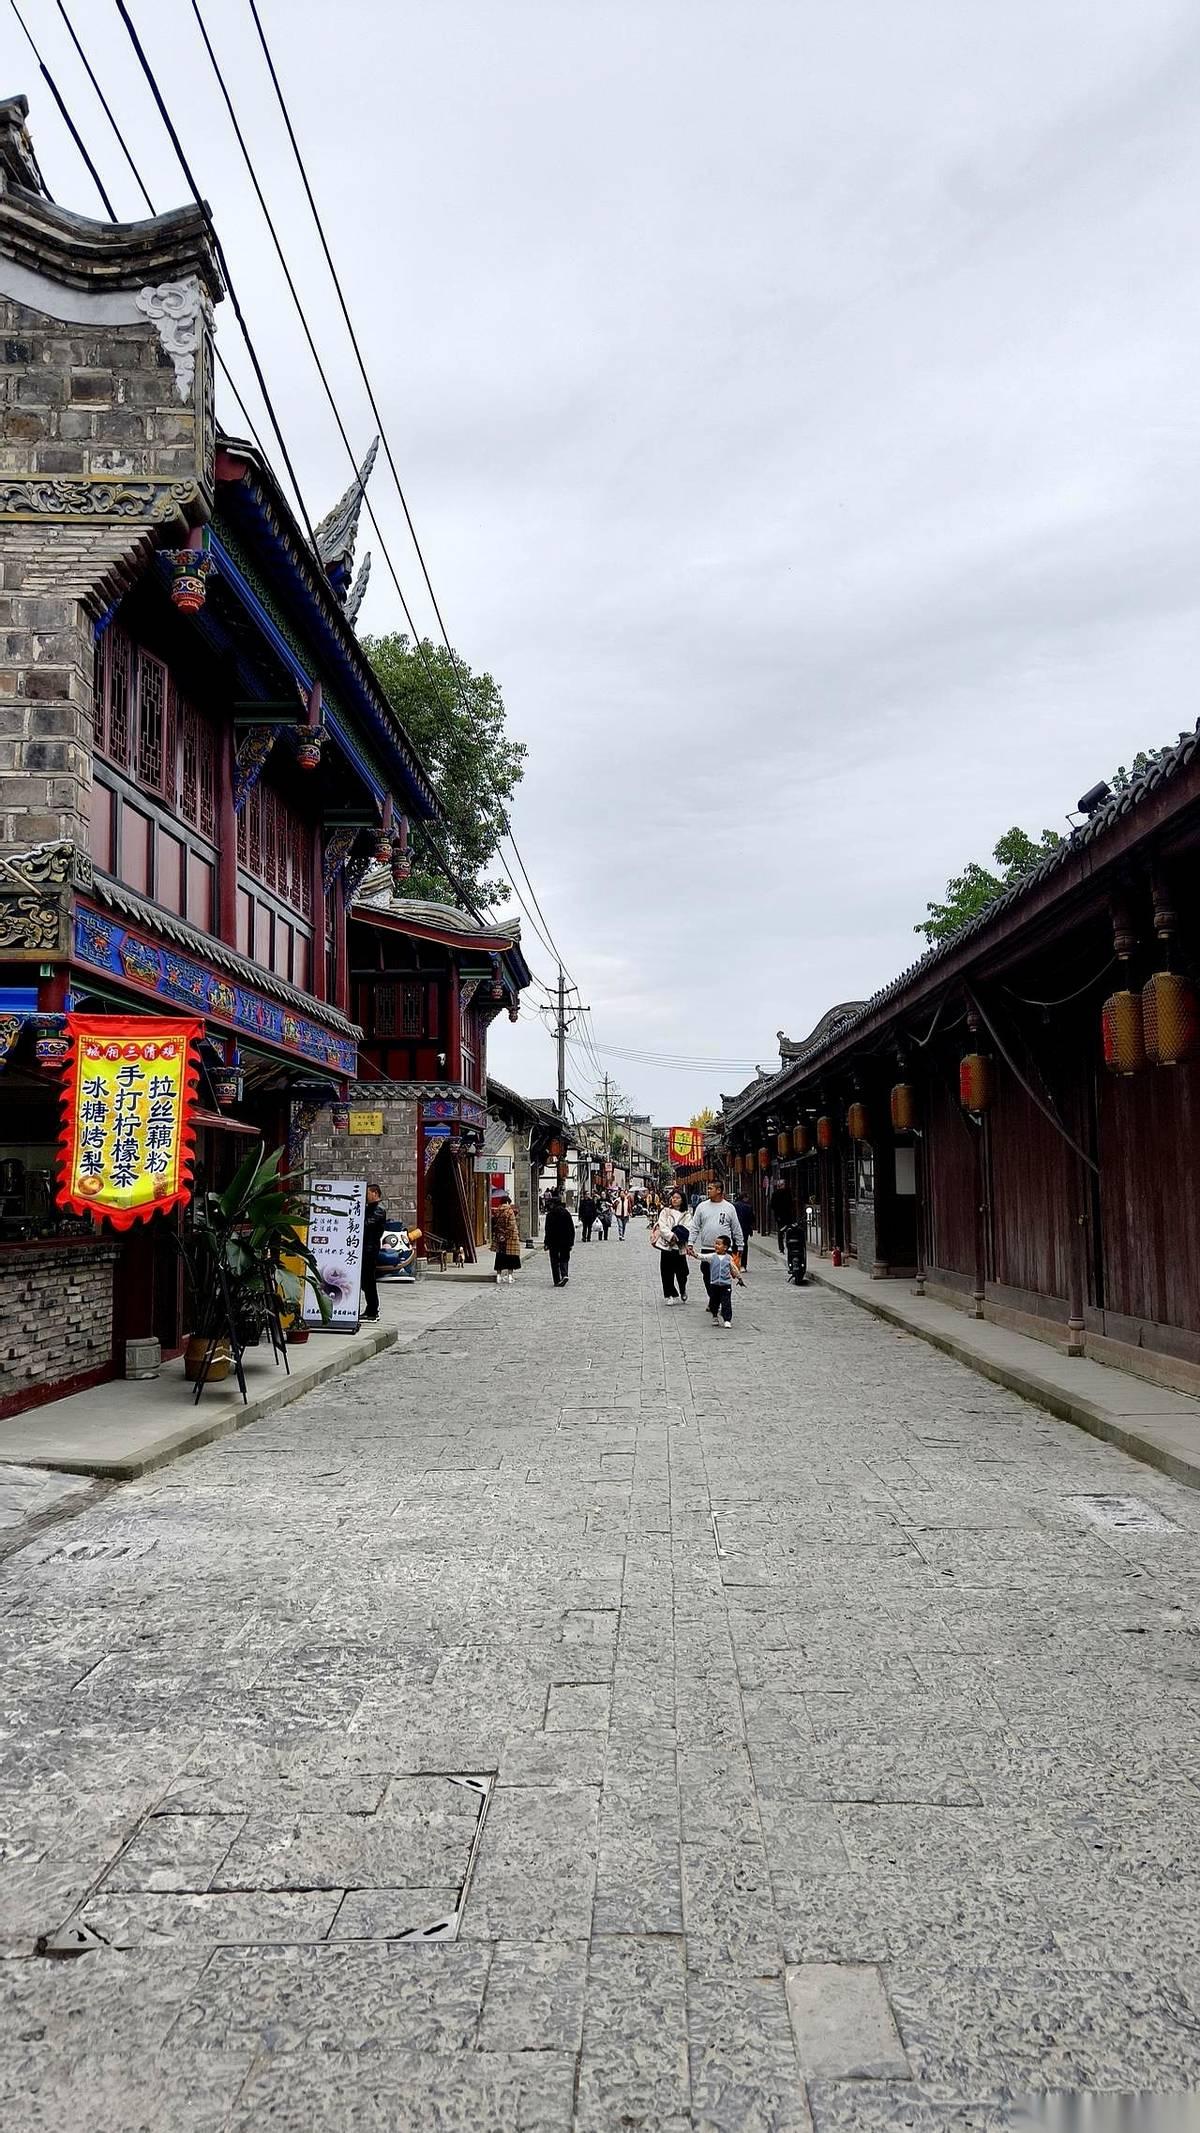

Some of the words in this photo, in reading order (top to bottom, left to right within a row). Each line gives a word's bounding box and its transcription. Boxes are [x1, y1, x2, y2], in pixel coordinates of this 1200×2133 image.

[87, 1044, 177, 1059] 城厢三清观
[80, 1076, 109, 1175] 冰糖烤梨
[110, 1064, 145, 1188] 手打柠檬茶
[144, 1076, 177, 1174] 拉丝藕粉
[486, 1158, 498, 1170] 药
